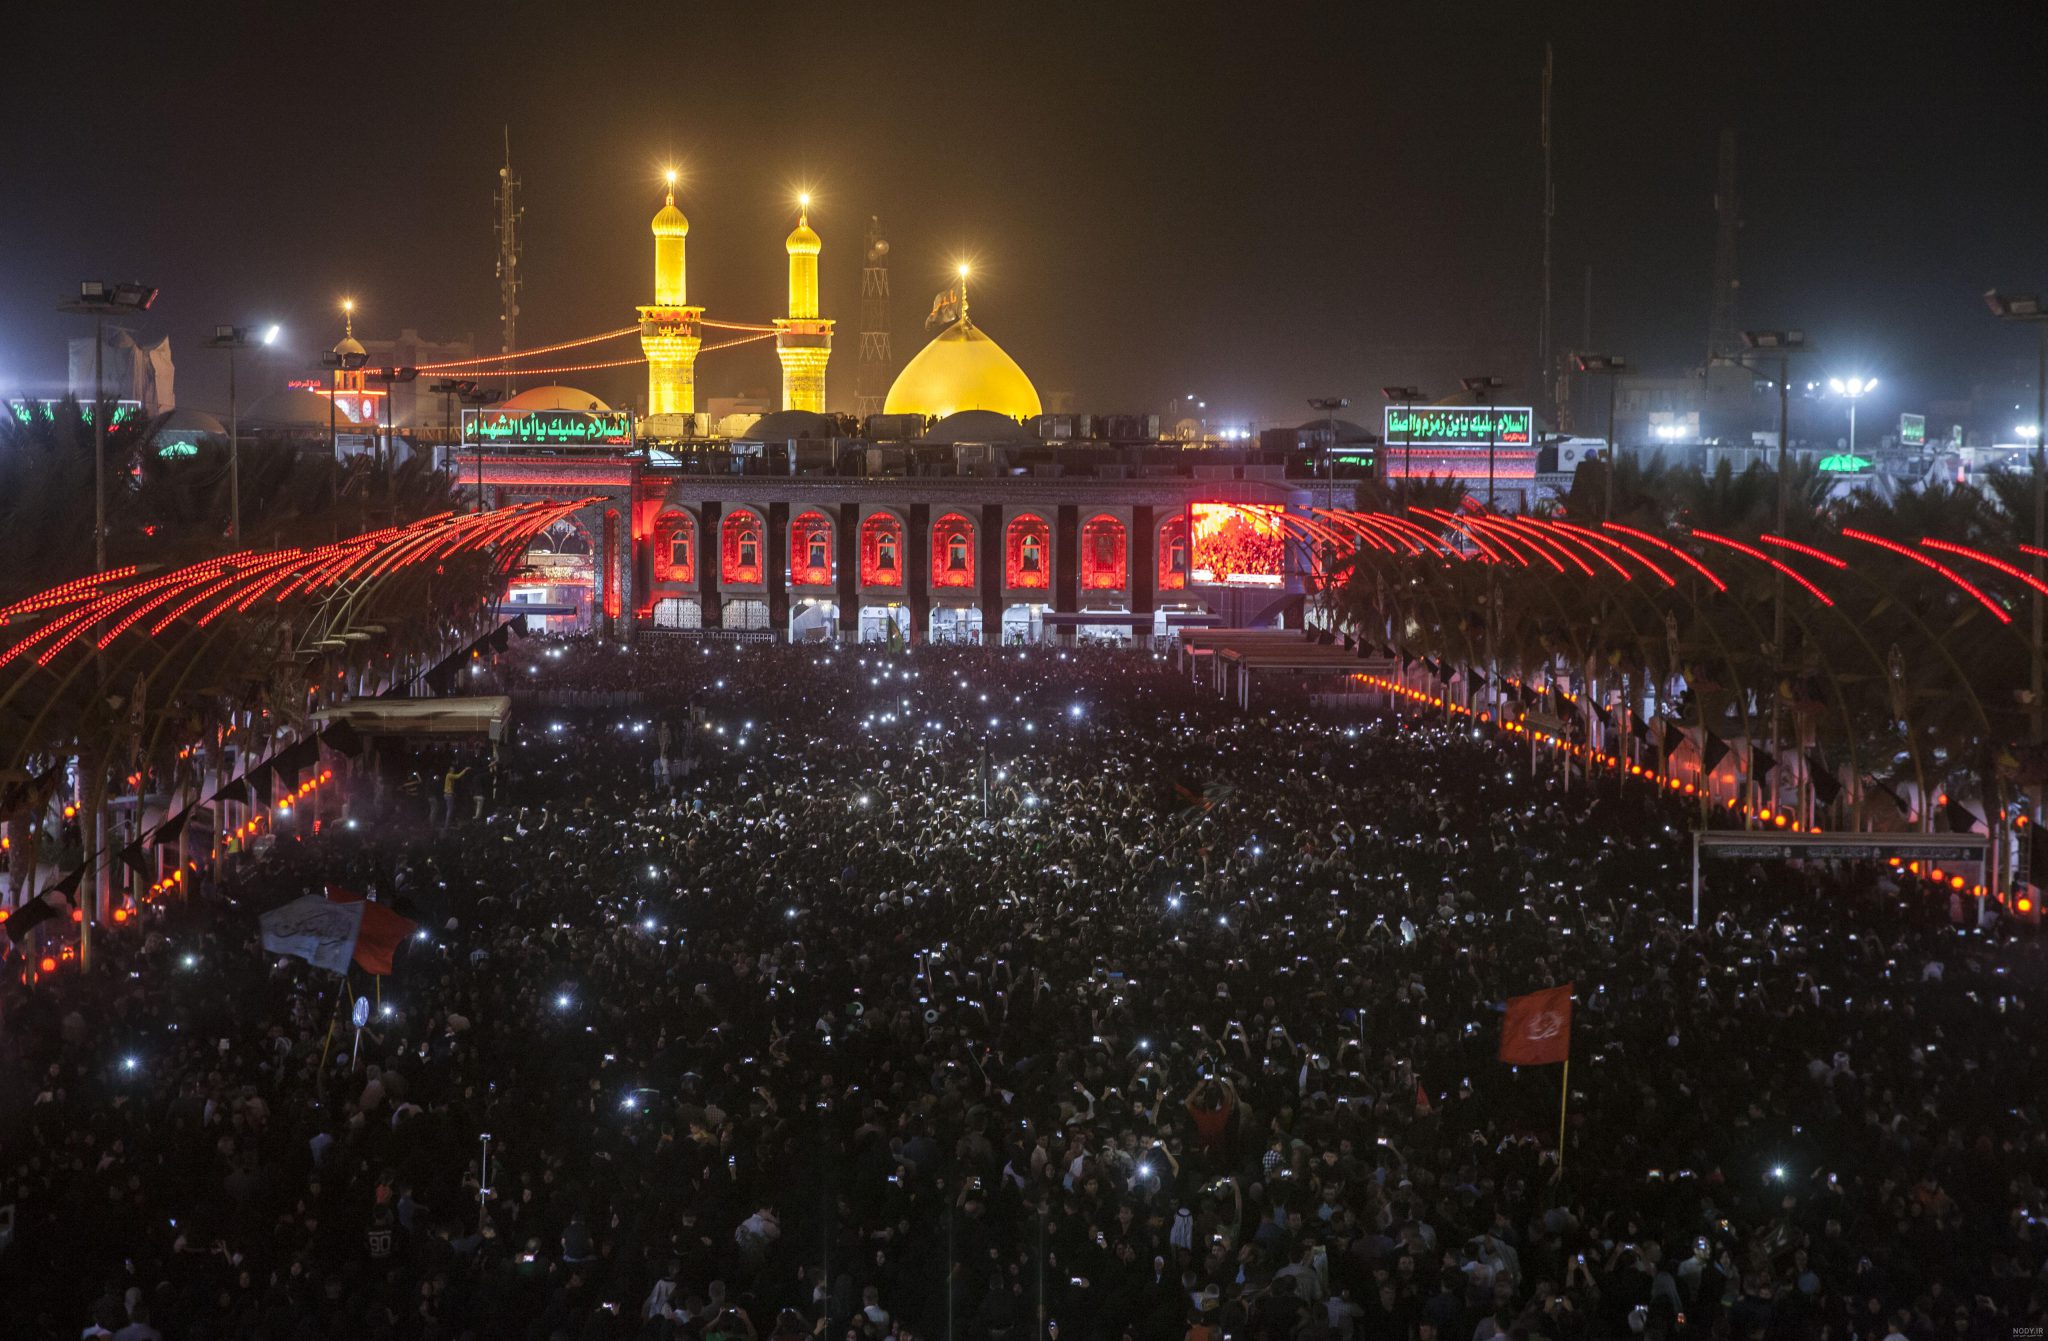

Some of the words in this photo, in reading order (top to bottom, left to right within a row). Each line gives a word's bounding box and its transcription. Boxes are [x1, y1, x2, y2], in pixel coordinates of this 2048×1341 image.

[465, 414, 518, 440] الشهداء
[548, 418, 585, 442] عليك
[587, 417, 630, 441] السلام
[1422, 413, 1446, 437] زمزم
[1497, 414, 1528, 438] السلام
